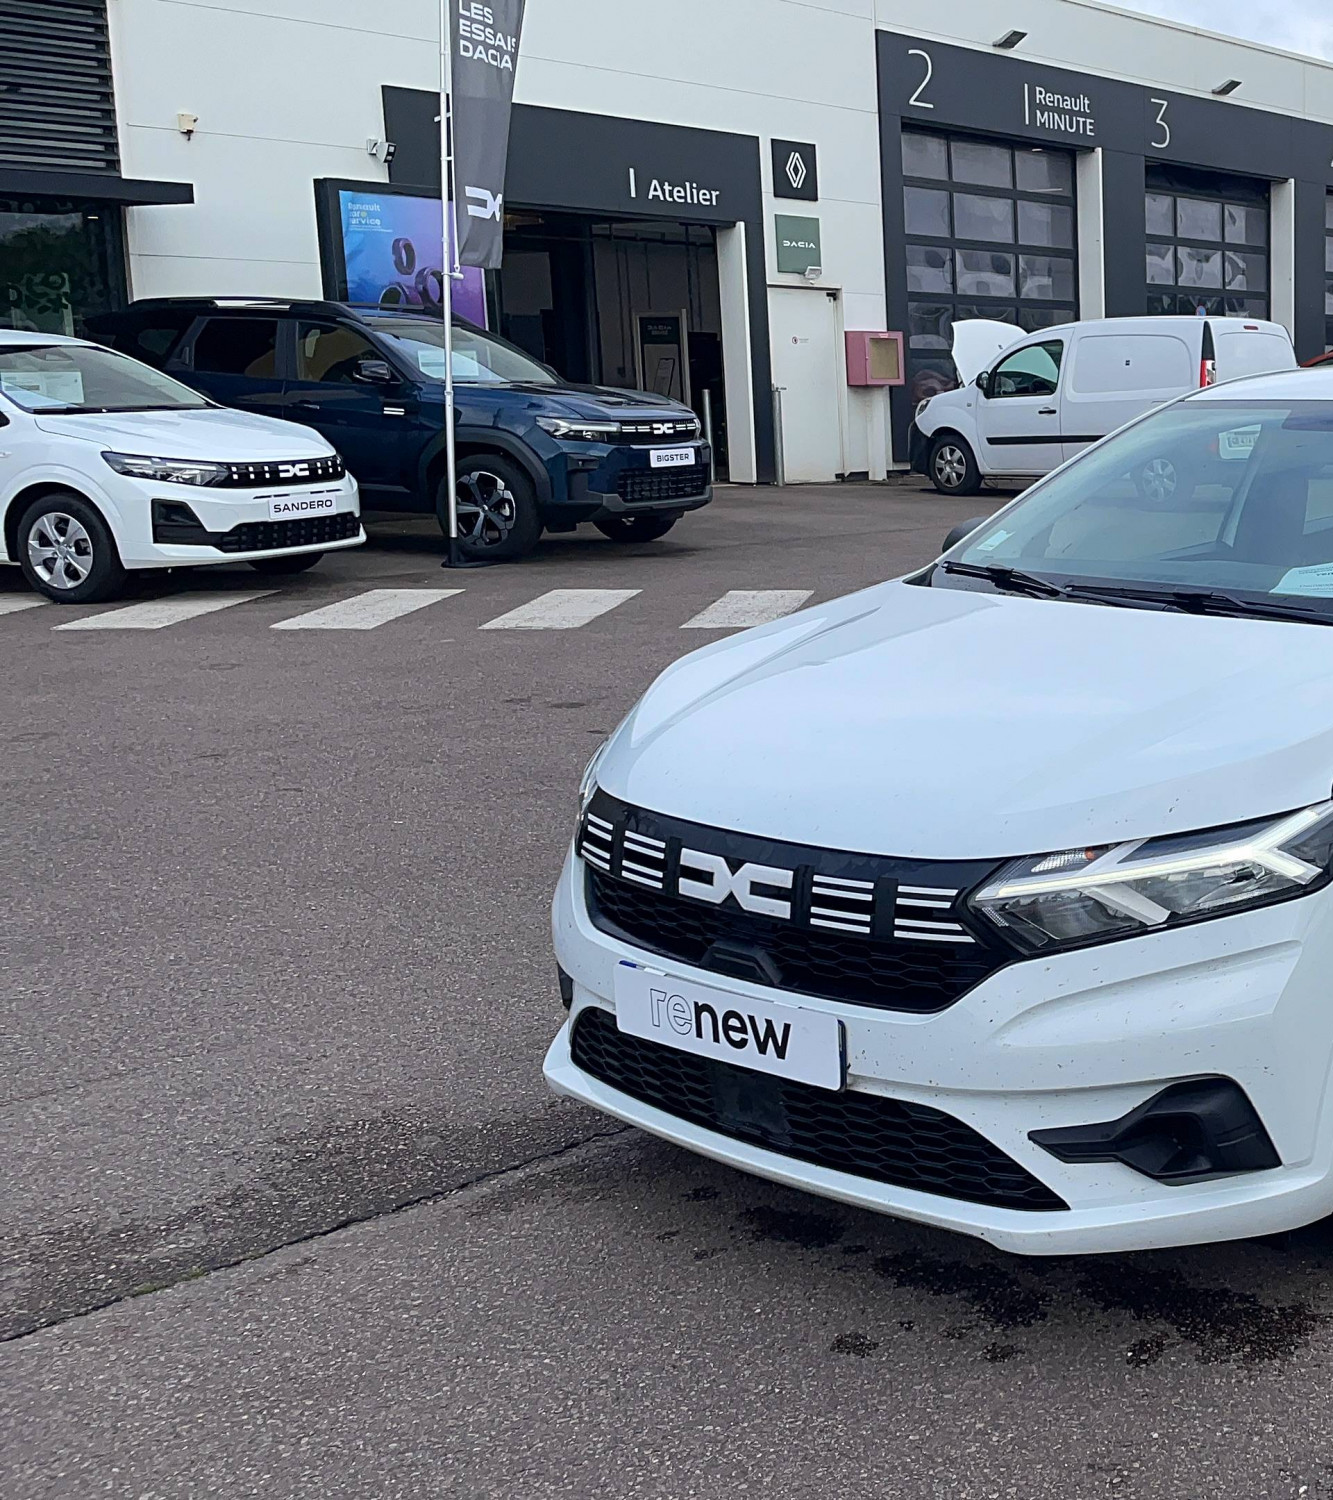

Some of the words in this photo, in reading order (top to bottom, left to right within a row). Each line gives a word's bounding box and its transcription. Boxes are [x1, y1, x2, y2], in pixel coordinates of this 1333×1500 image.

[459, 0, 494, 24] LES
[460, 39, 513, 72] DACIA
[907, 49, 935, 109] 2
[1035, 86, 1091, 114] Renault
[1035, 109, 1096, 137] MINUTE
[1150, 97, 1171, 149] 3
[648, 179, 720, 206] Atelier
[782, 240, 816, 249] DACIA
[656, 453, 690, 463] BIGSTER
[273, 499, 333, 513] SANDERO
[649, 987, 792, 1061] renew
